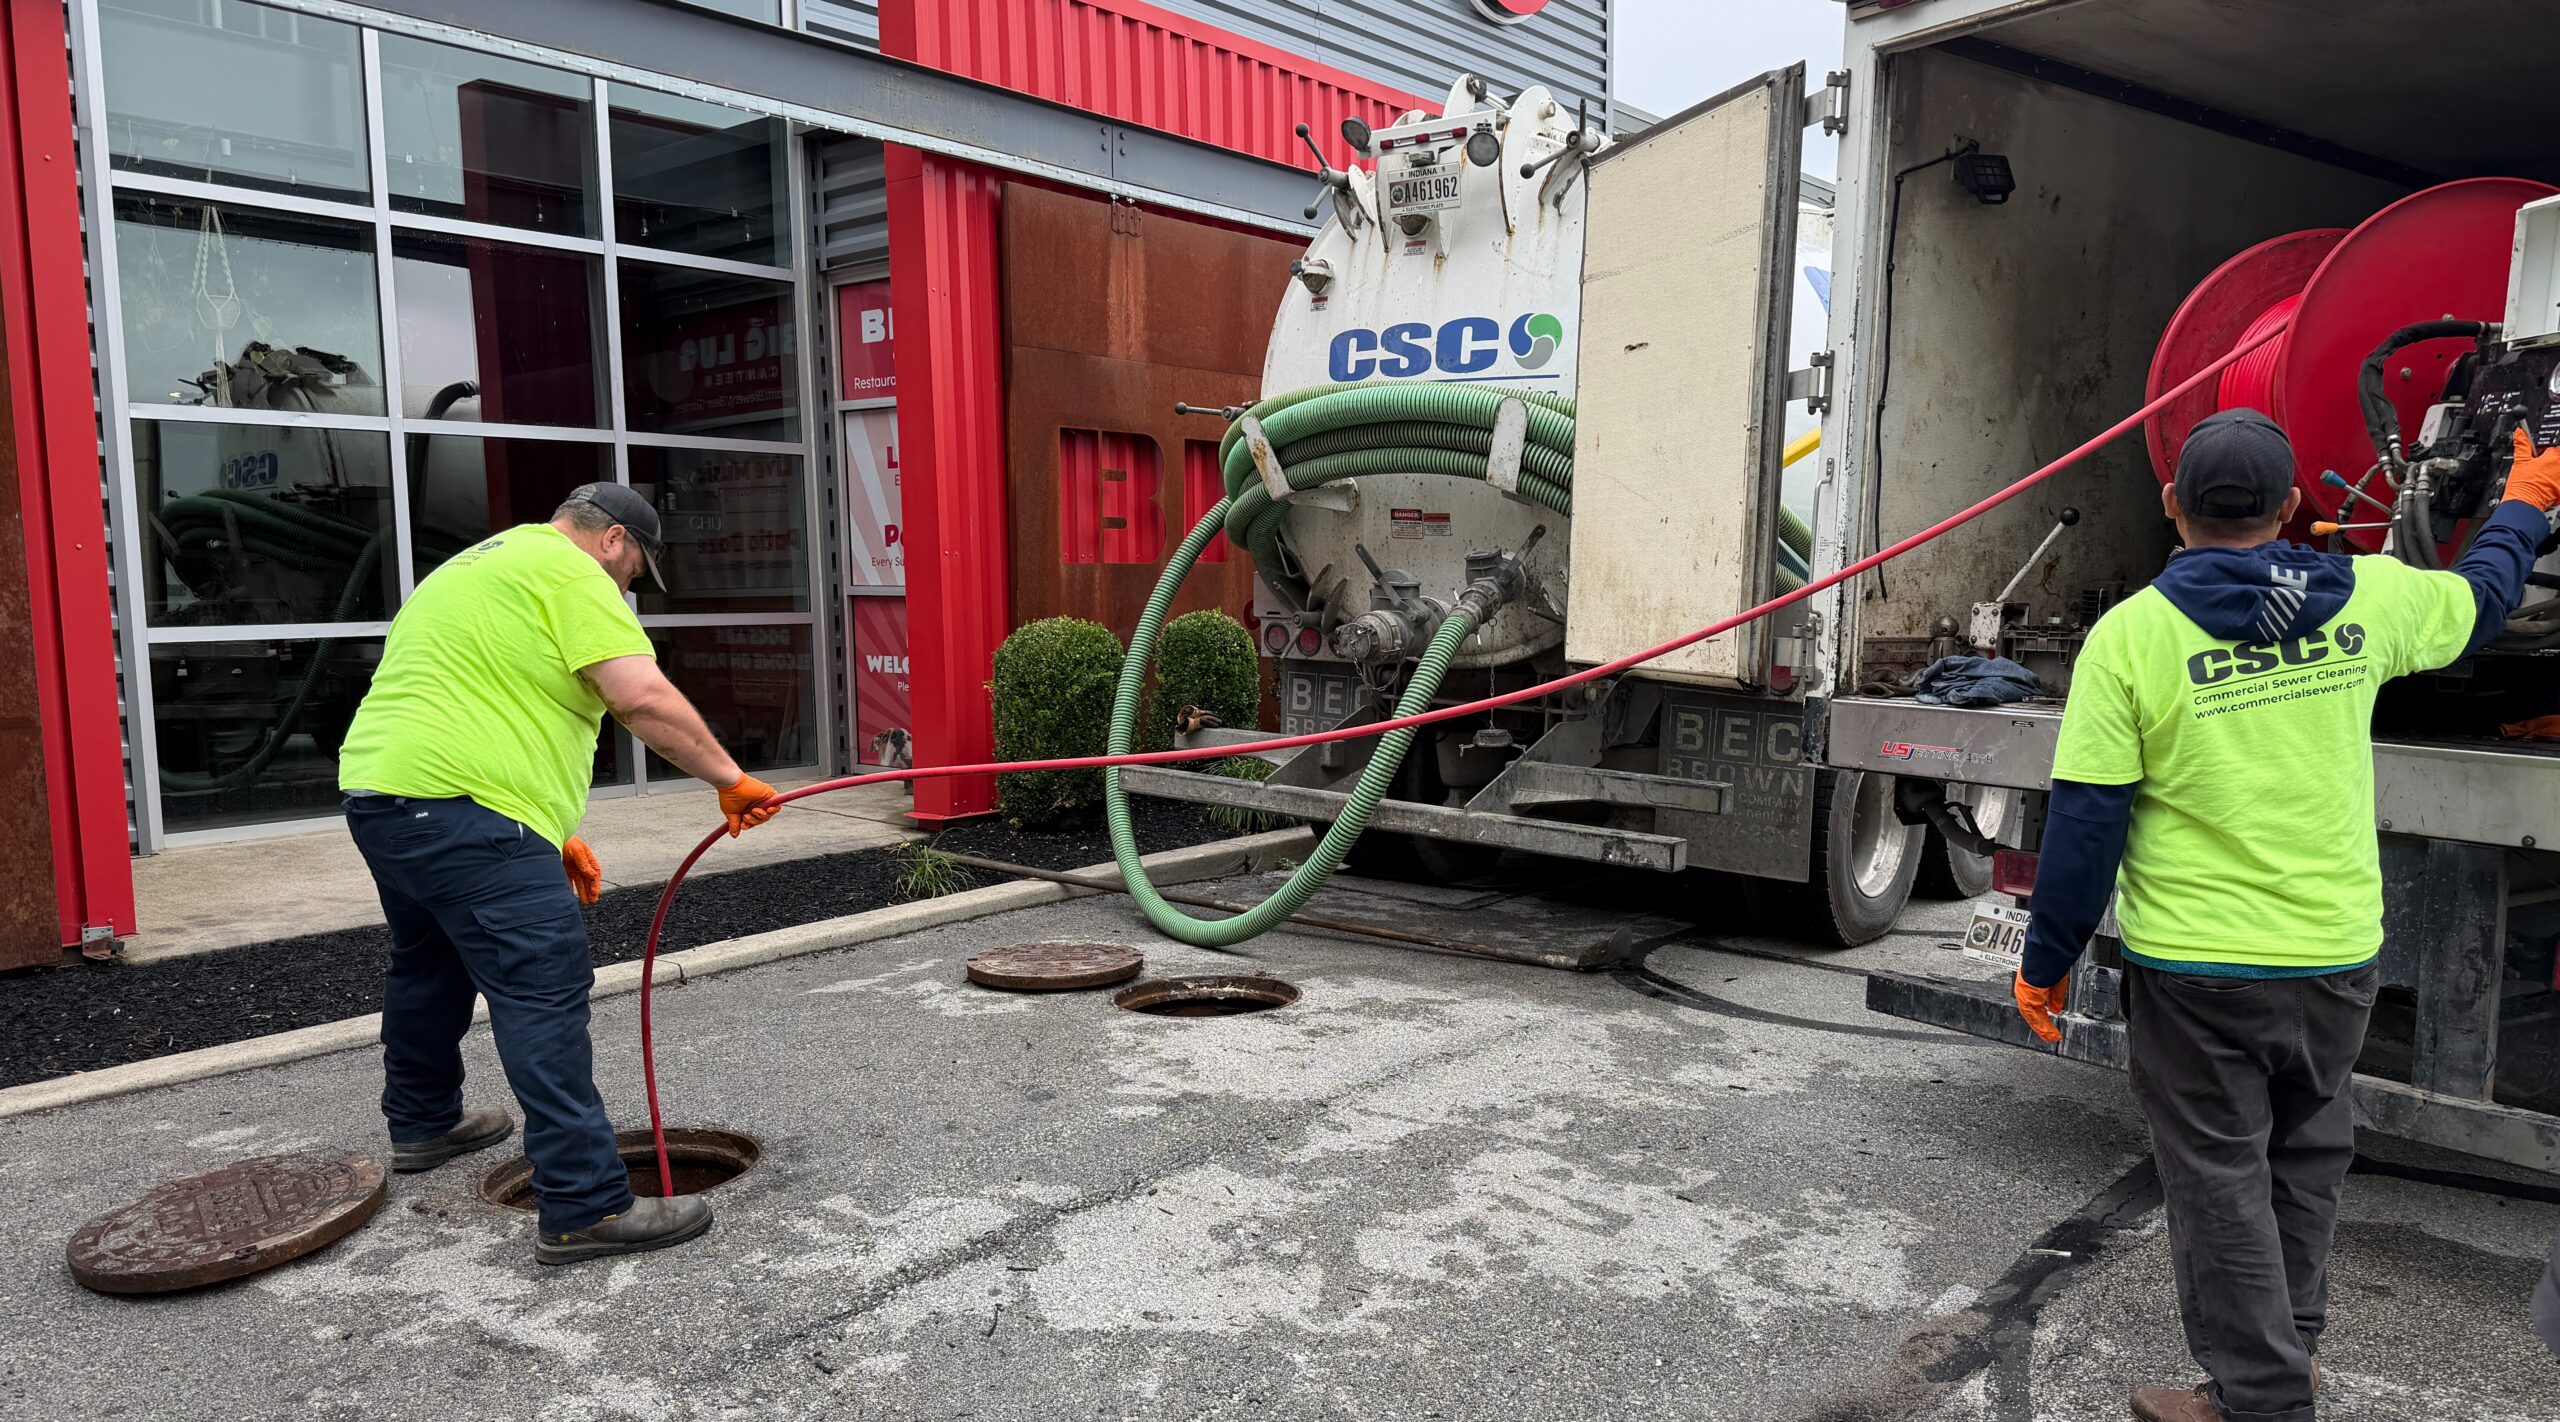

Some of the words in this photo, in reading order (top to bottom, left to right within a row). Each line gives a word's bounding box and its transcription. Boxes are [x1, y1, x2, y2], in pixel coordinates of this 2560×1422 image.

[1408, 167, 1438, 179] INDIANA
[1405, 176, 1458, 204] A461962
[1406, 204, 1431, 213] ELECTRONIC
[1329, 316, 1500, 382] CSC
[854, 375, 896, 390] Restaura
[1060, 427, 1229, 564] BI
[871, 556, 893, 569] Every
[866, 655, 909, 674] WELC
[2187, 629, 2329, 685] CSC
[897, 681, 910, 692] Ple
[2194, 681, 2268, 706] Commercial
[2272, 674, 2312, 689] Sewer
[2316, 664, 2368, 681] Cleaning
[2195, 678, 2365, 720] www.commercialsewer.com
[1675, 711, 1801, 763] BEC
[2005, 910, 2032, 924] INDIA
[1985, 953, 2021, 968] ELECTRONIC
